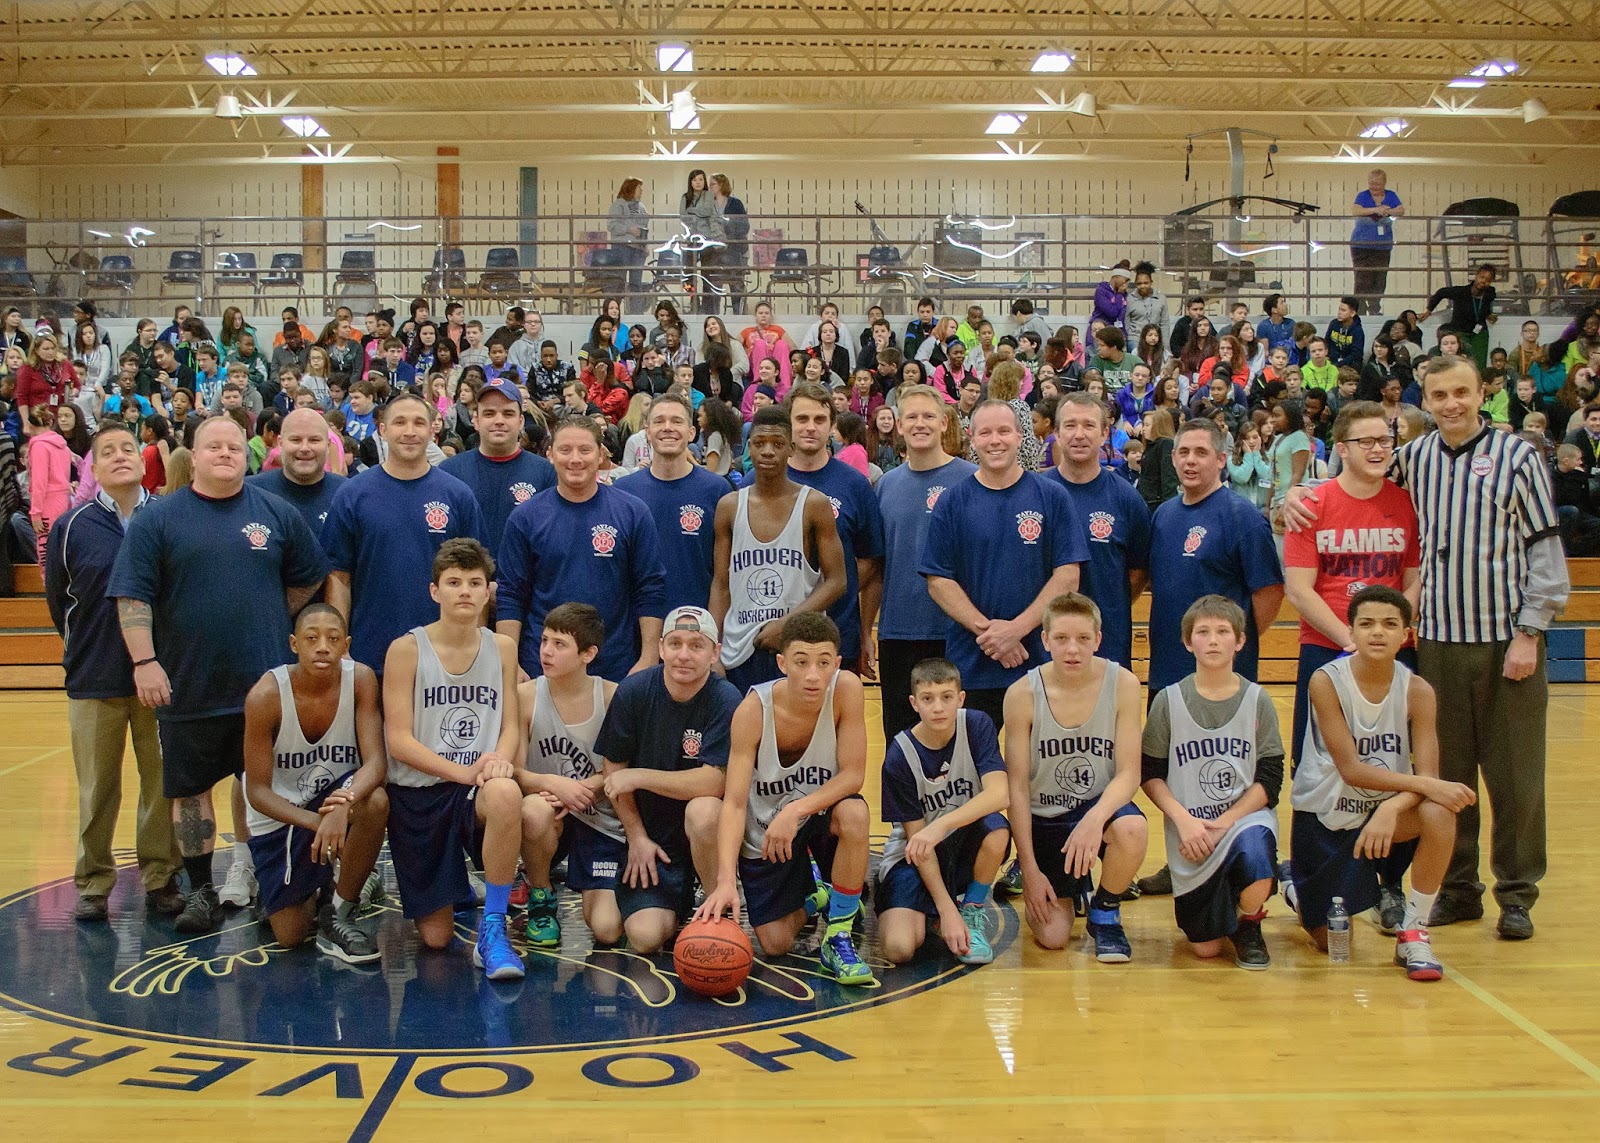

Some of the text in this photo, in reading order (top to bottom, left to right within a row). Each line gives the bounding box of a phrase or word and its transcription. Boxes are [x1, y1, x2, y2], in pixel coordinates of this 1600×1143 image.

[348, 420, 369, 441] 21
[509, 482, 537, 495] TAYLOR
[424, 501, 450, 513] TAYLOR
[679, 504, 705, 516] TAYLOR
[319, 511, 328, 523] TA
[1016, 510, 1043, 522] TAYLOR
[1089, 511, 1115, 524] TAYLOR
[241, 522, 272, 537] TAYLOR
[591, 523, 618, 536] TAYLOR
[1317, 528, 1405, 554] FLAMES
[732, 548, 803, 573] HOOVER
[1320, 553, 1403, 578] NATION
[763, 580, 776, 596] 11
[424, 685, 498, 711] HOOVER
[458, 720, 475, 738] 21
[277, 745, 358, 769] HOOVER
[1175, 737, 1252, 767] HOOVER
[314, 778, 330, 794] 12
[757, 766, 832, 797] HOOVER
[1074, 768, 1089, 787] 14
[1217, 772, 1231, 789] 13
[1040, 793, 1084, 810] BASKET
[1187, 801, 1233, 820] BASKET
[592, 861, 618, 870] HOOVE
[592, 869, 616, 878] HAWK
[683, 943, 735, 964] Rawlings
[684, 969, 732, 984] EDGE
[7, 1030, 857, 1100] HOOVER
